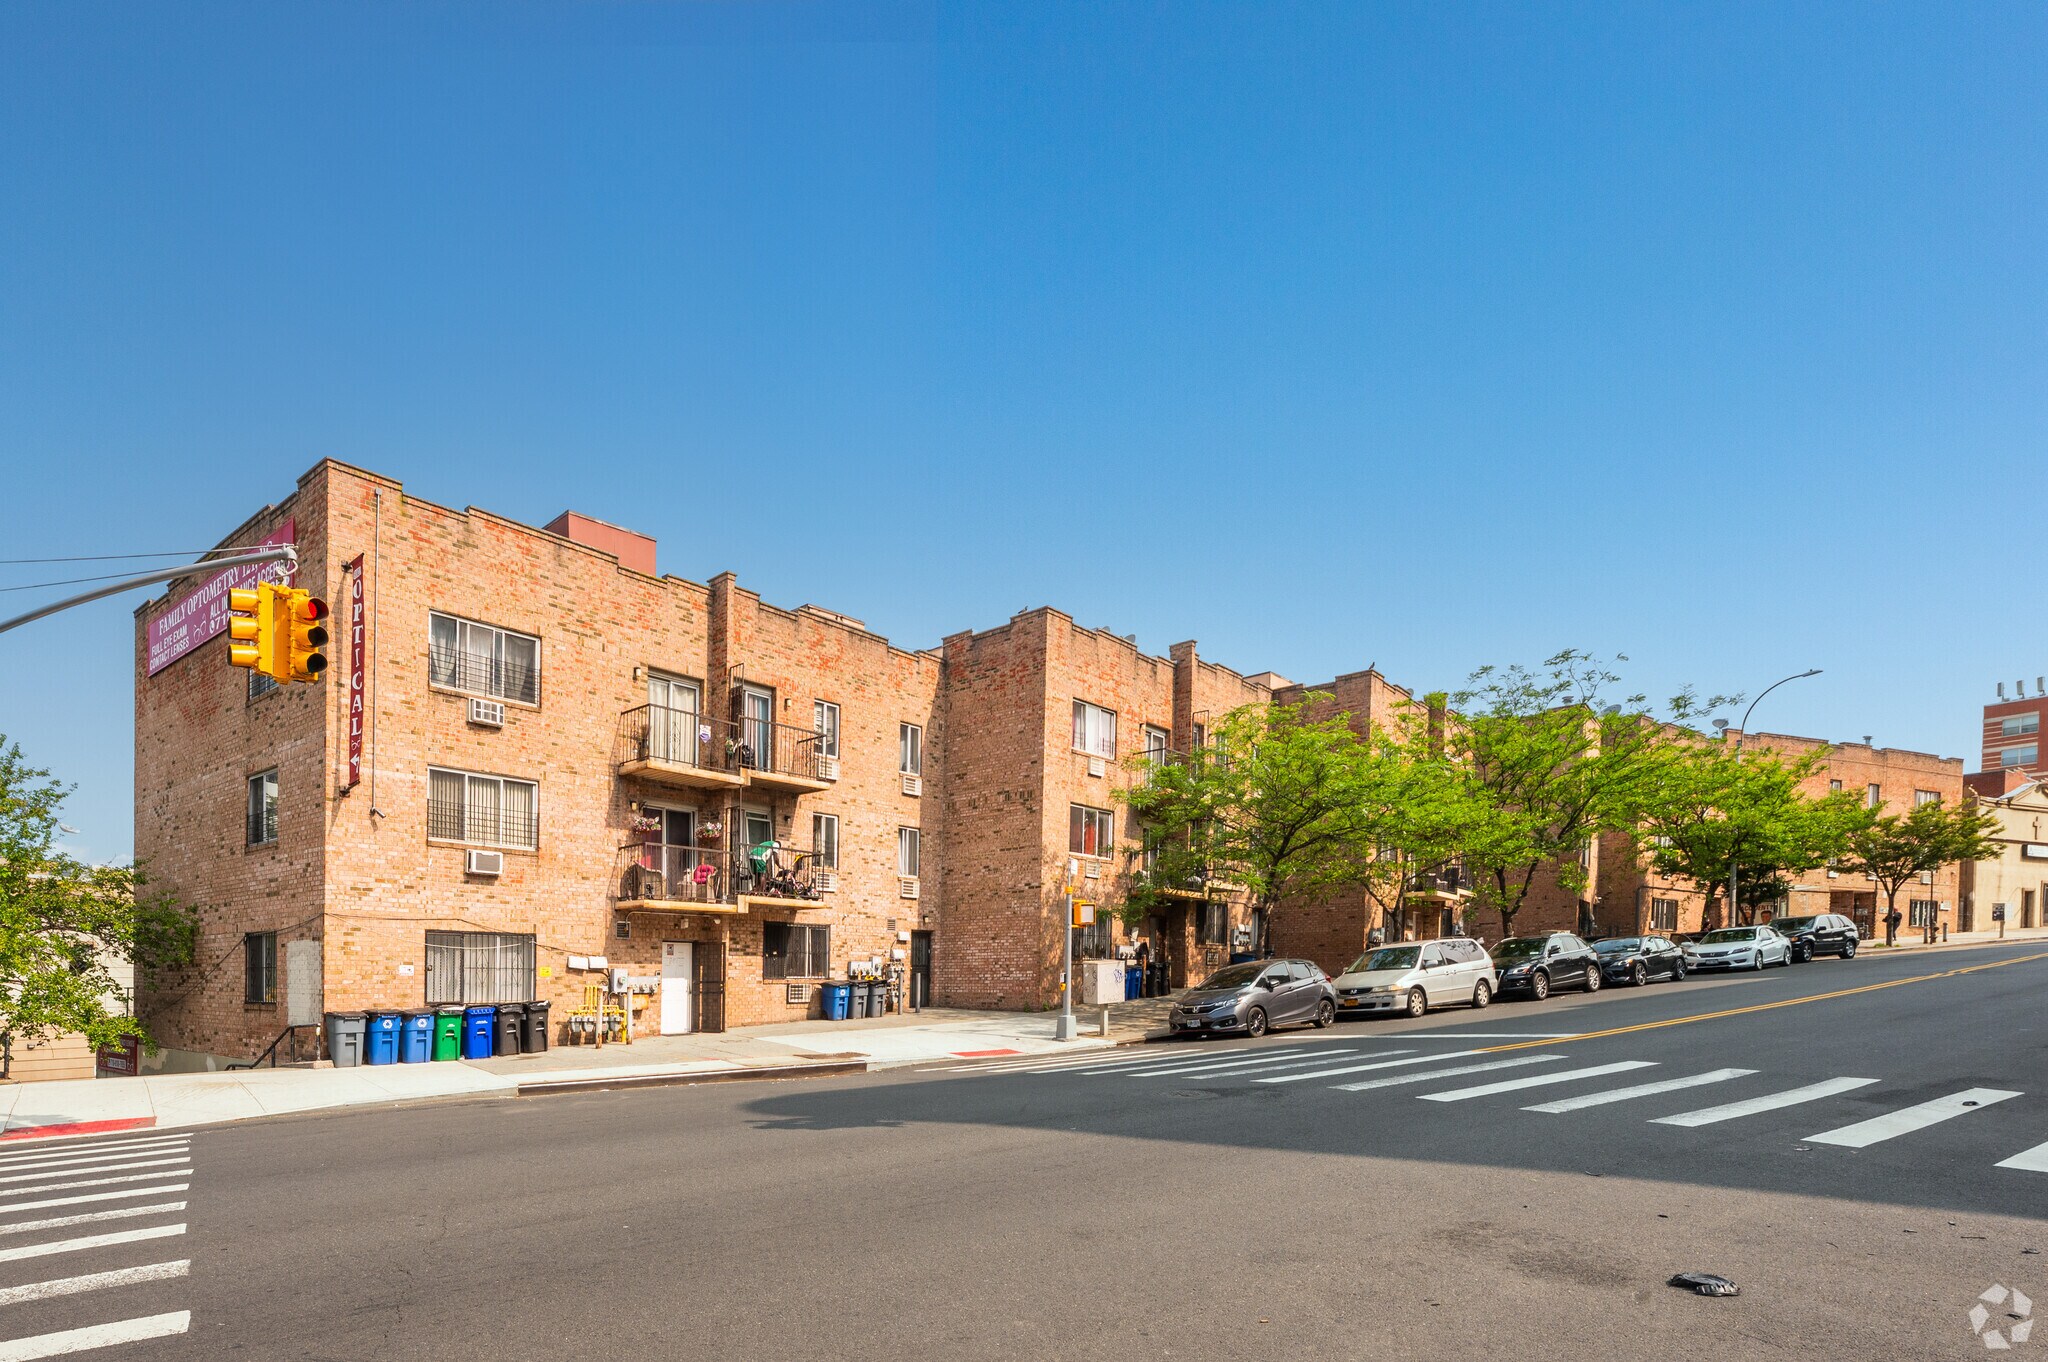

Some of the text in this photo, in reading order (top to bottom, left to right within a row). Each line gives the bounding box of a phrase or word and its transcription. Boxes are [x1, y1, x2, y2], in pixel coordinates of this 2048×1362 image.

[159, 601, 187, 636] FAMILY
[187, 566, 240, 615] OPTOMETRY
[210, 600, 221, 620] ALL
[150, 635, 189, 670] CONTACT LENSES
[151, 624, 188, 657] FULL EYE EXAM
[351, 579, 364, 735] OPTICAL
